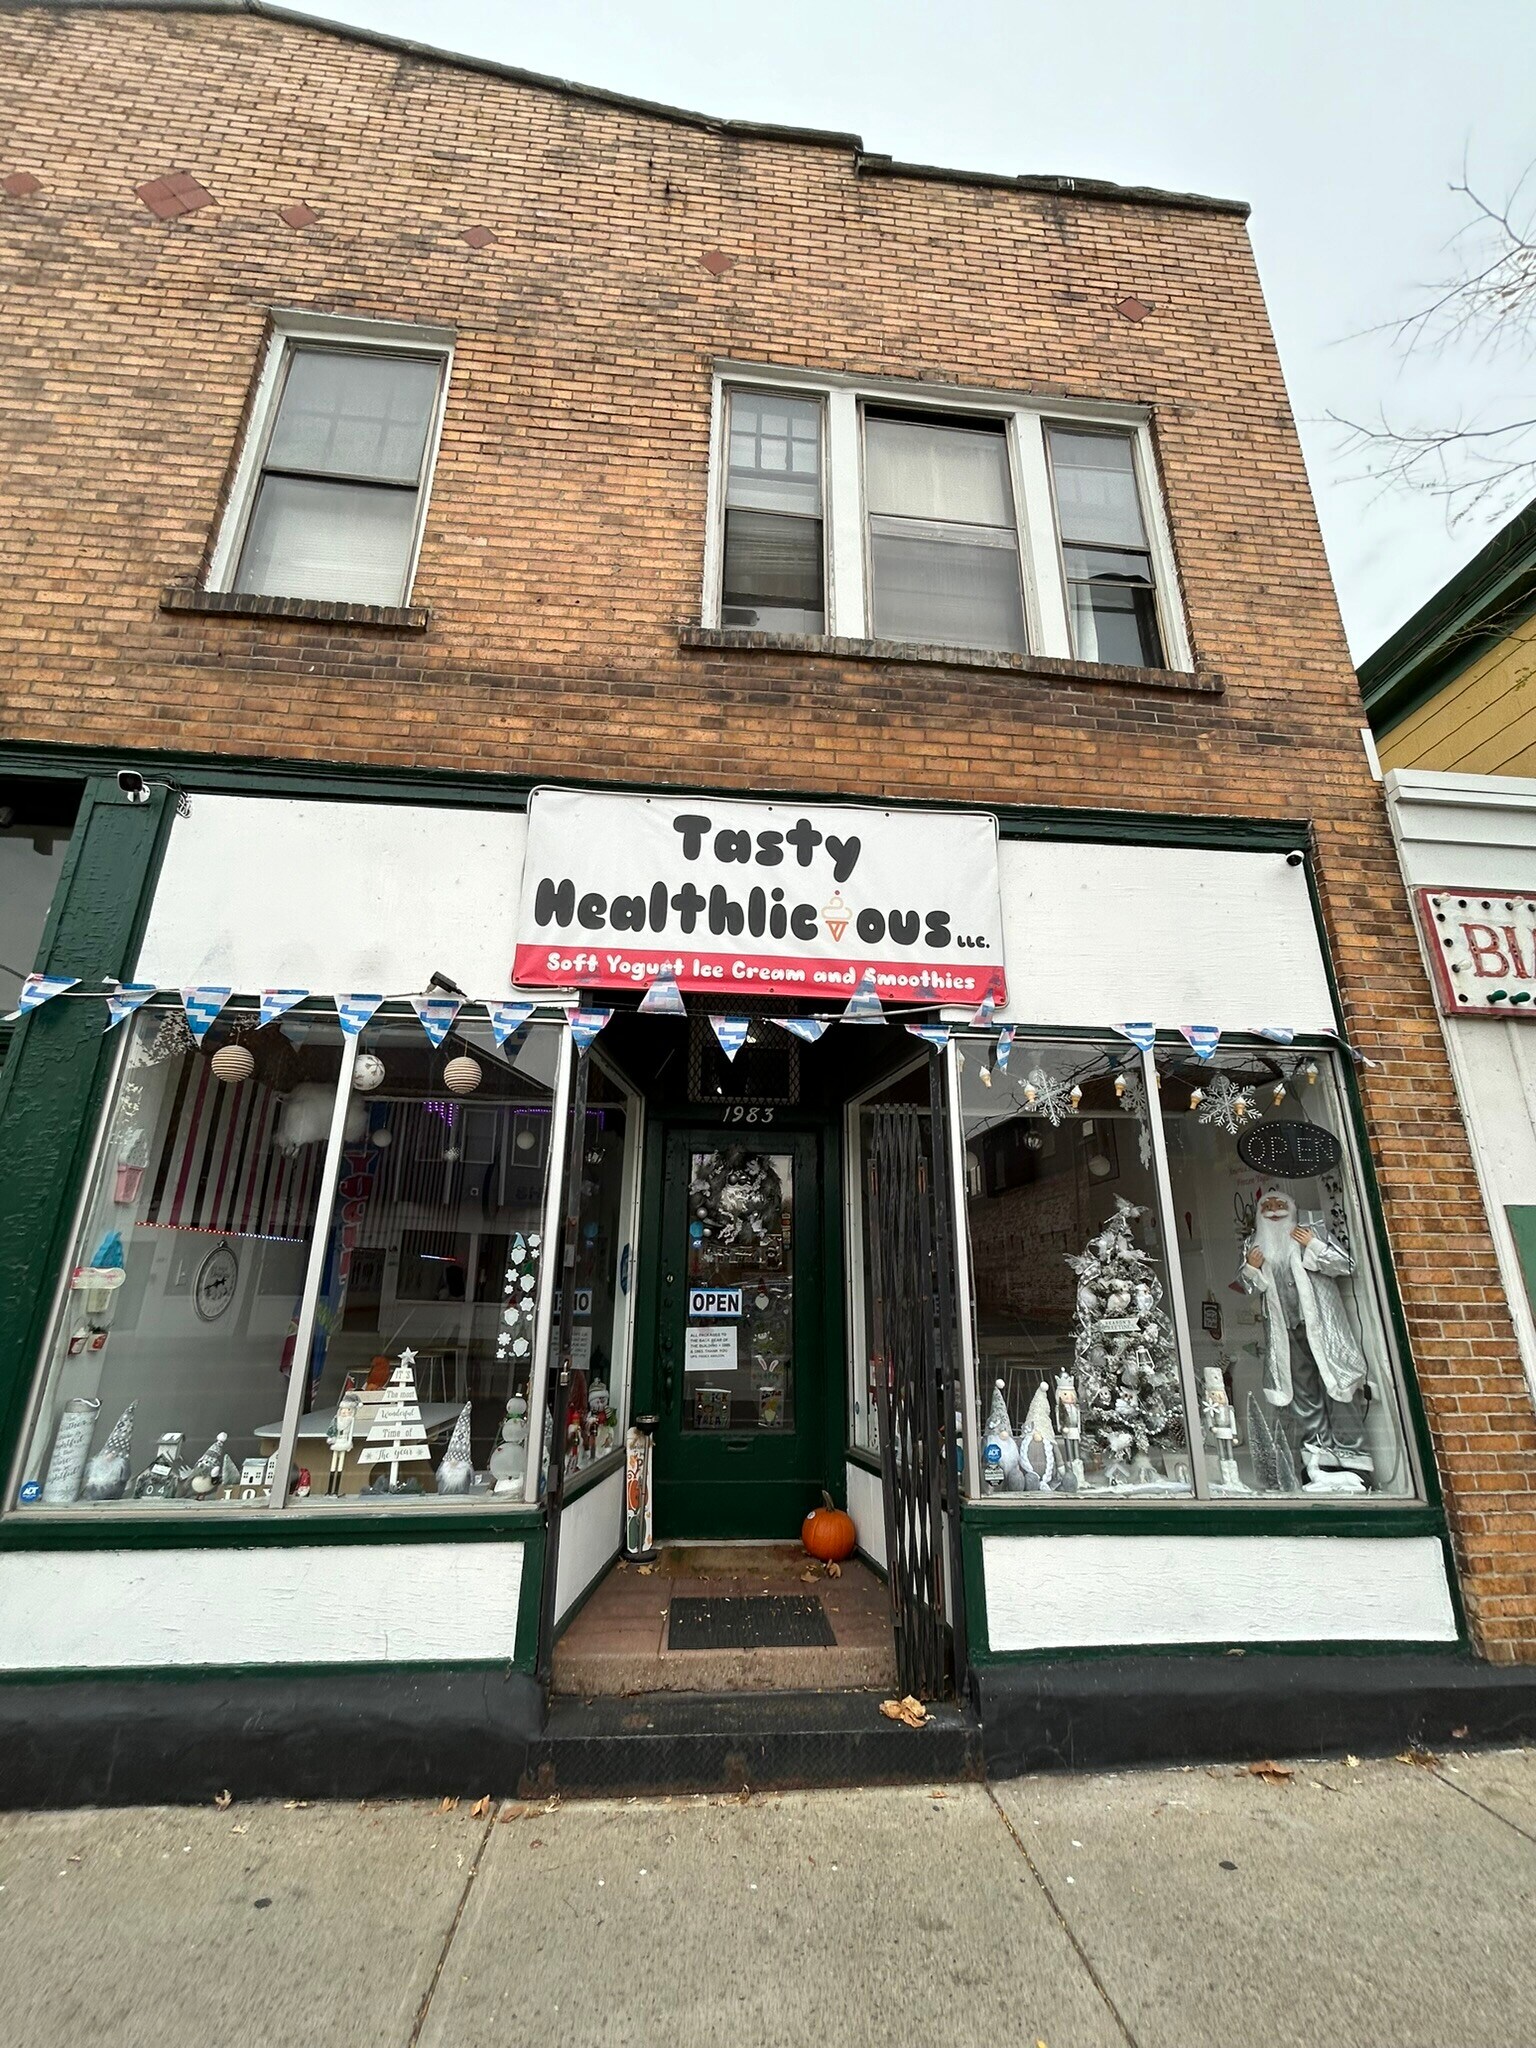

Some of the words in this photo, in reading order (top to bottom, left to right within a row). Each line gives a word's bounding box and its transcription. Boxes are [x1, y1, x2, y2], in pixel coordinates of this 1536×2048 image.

[672, 814, 862, 883] Tasty
[1459, 921, 1536, 979] BI
[546, 952, 599, 973] Soft
[692, 959, 724, 978] Ice
[731, 960, 806, 983] Cream
[813, 966, 857, 985] and
[863, 967, 976, 990] Smoothies
[722, 1106, 775, 1123] 1983
[1247, 1136, 1335, 1162] OPEN
[692, 1293, 740, 1312] OPEN
